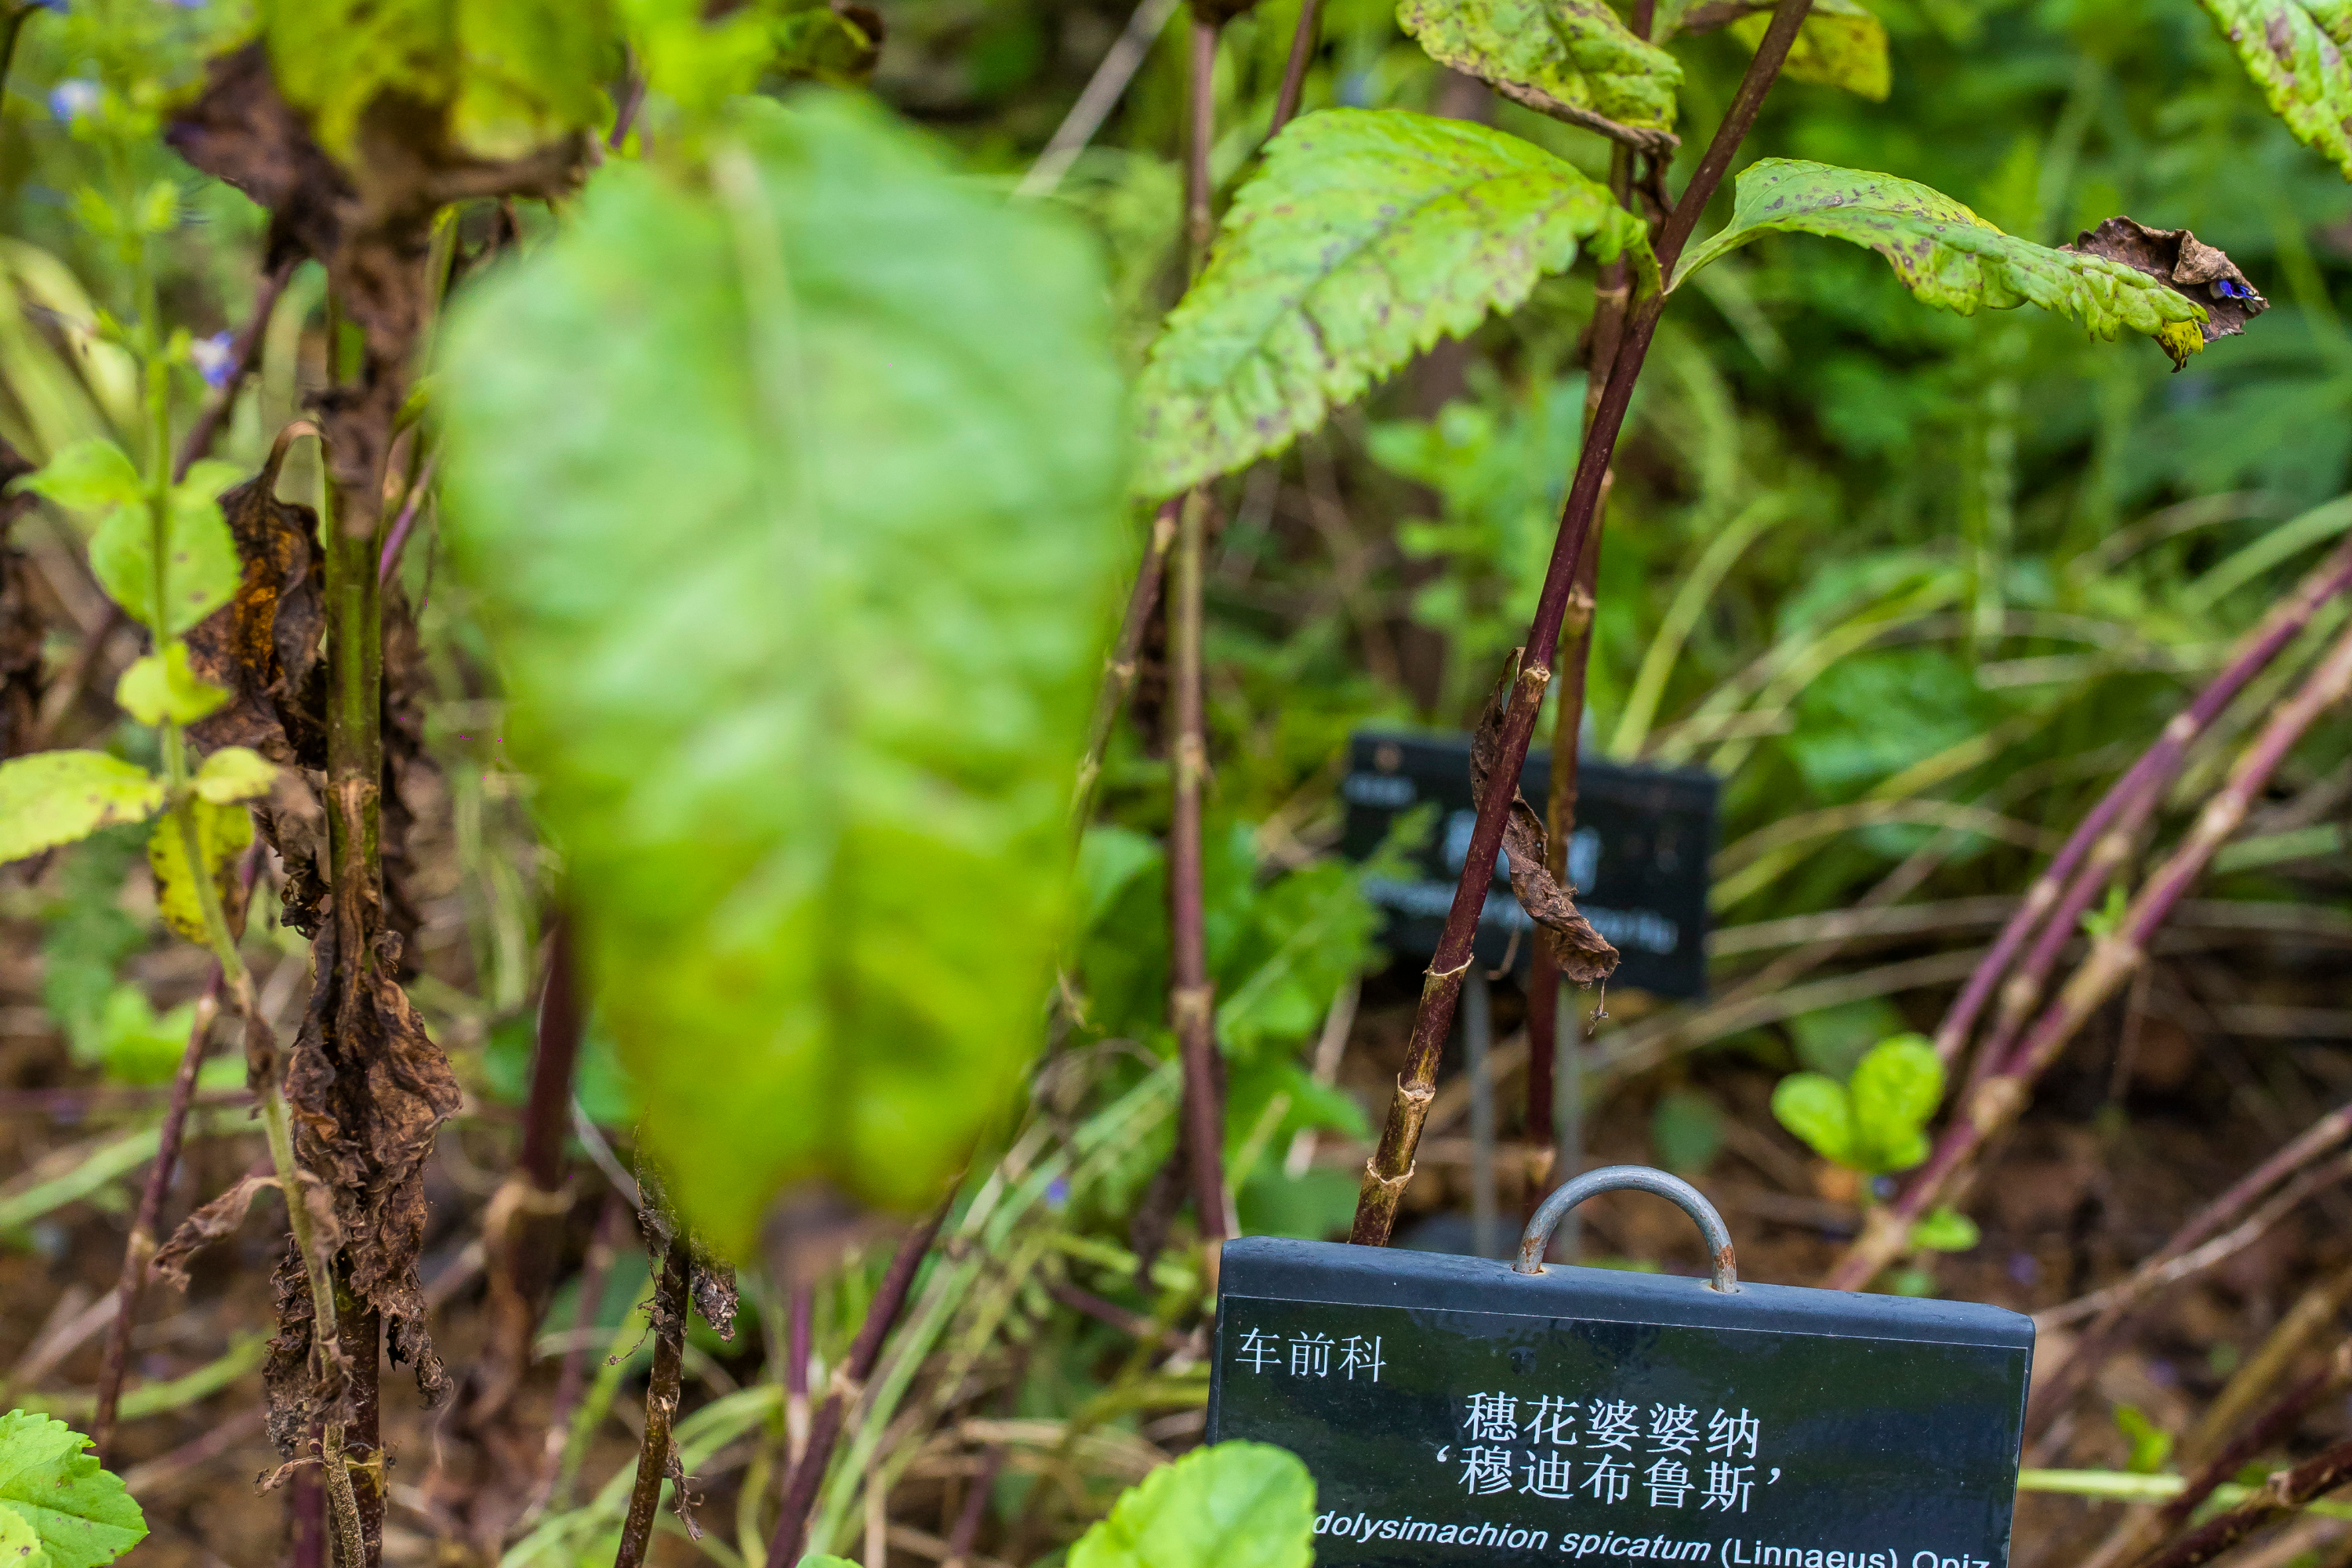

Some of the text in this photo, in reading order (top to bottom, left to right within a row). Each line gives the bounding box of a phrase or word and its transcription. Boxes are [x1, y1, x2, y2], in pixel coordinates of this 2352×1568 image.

[1235, 1327, 1387, 1382] 车前科
[1462, 1391, 1761, 1459] 穗花婆婆纳
[1559, 1530, 1711, 1561] spicatum
[1721, 1537, 1898, 1568] (Linnaeus)
